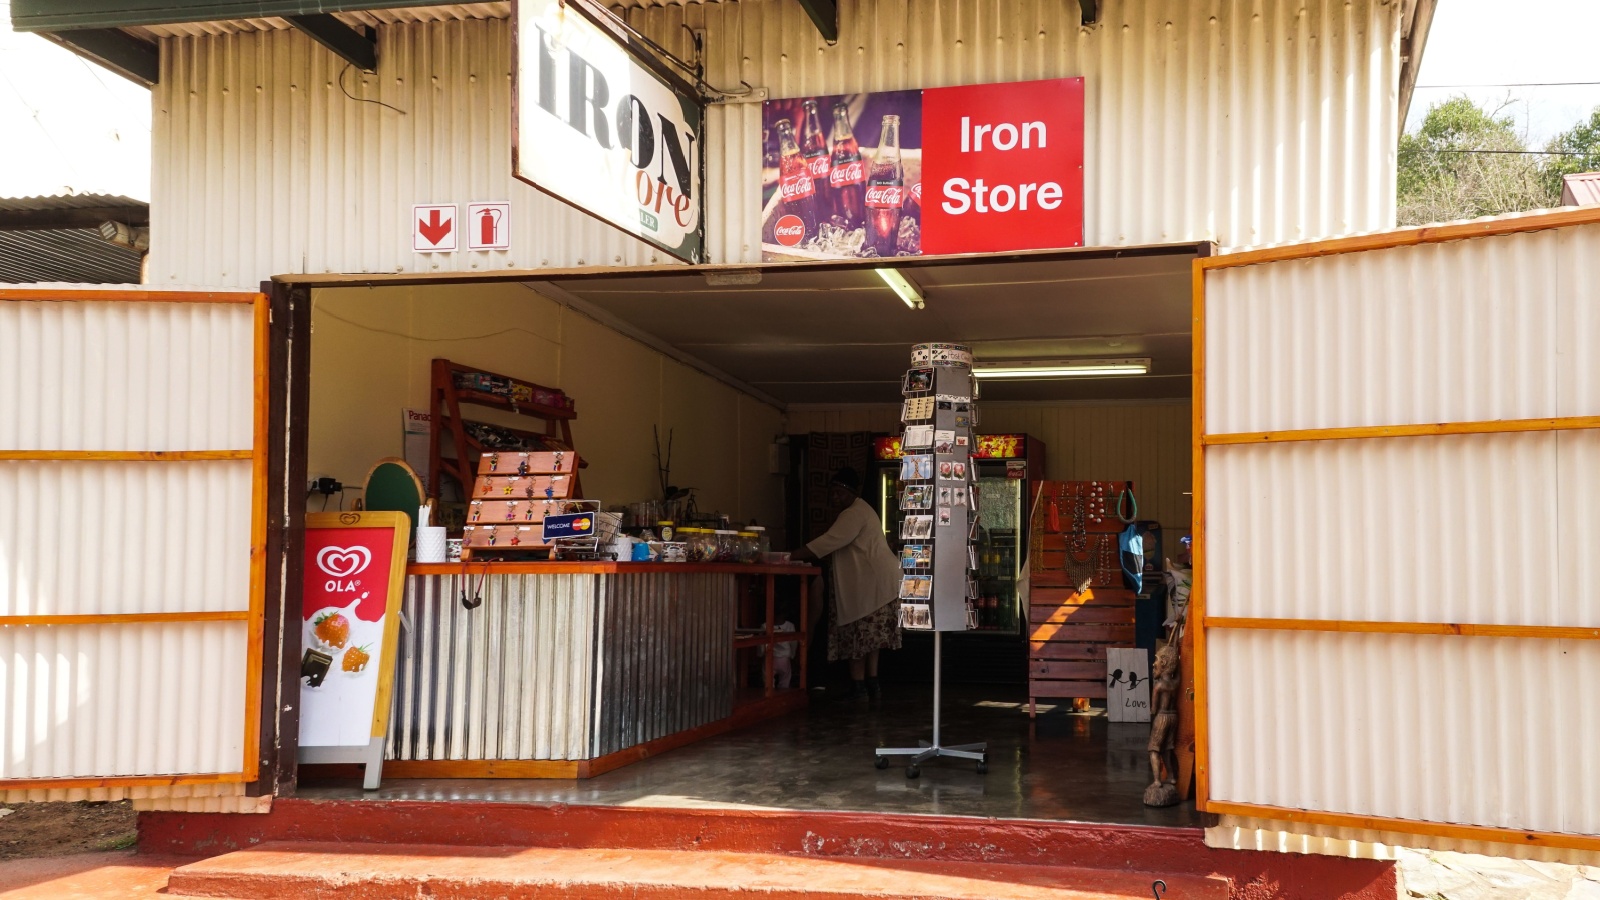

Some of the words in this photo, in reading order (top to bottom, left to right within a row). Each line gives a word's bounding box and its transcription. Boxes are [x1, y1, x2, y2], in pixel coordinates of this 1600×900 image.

[534, 22, 696, 199] IRON
[960, 116, 1047, 153] Iron
[830, 163, 862, 184] Coca-Cola
[781, 177, 812, 198] Coca-Cola
[865, 187, 902, 204] Coca-Cola
[941, 177, 1063, 215] Store
[776, 225, 803, 236] Coca-Cola
[547, 522, 571, 530] WELCOME
[1125, 698, 1148, 709] Love
